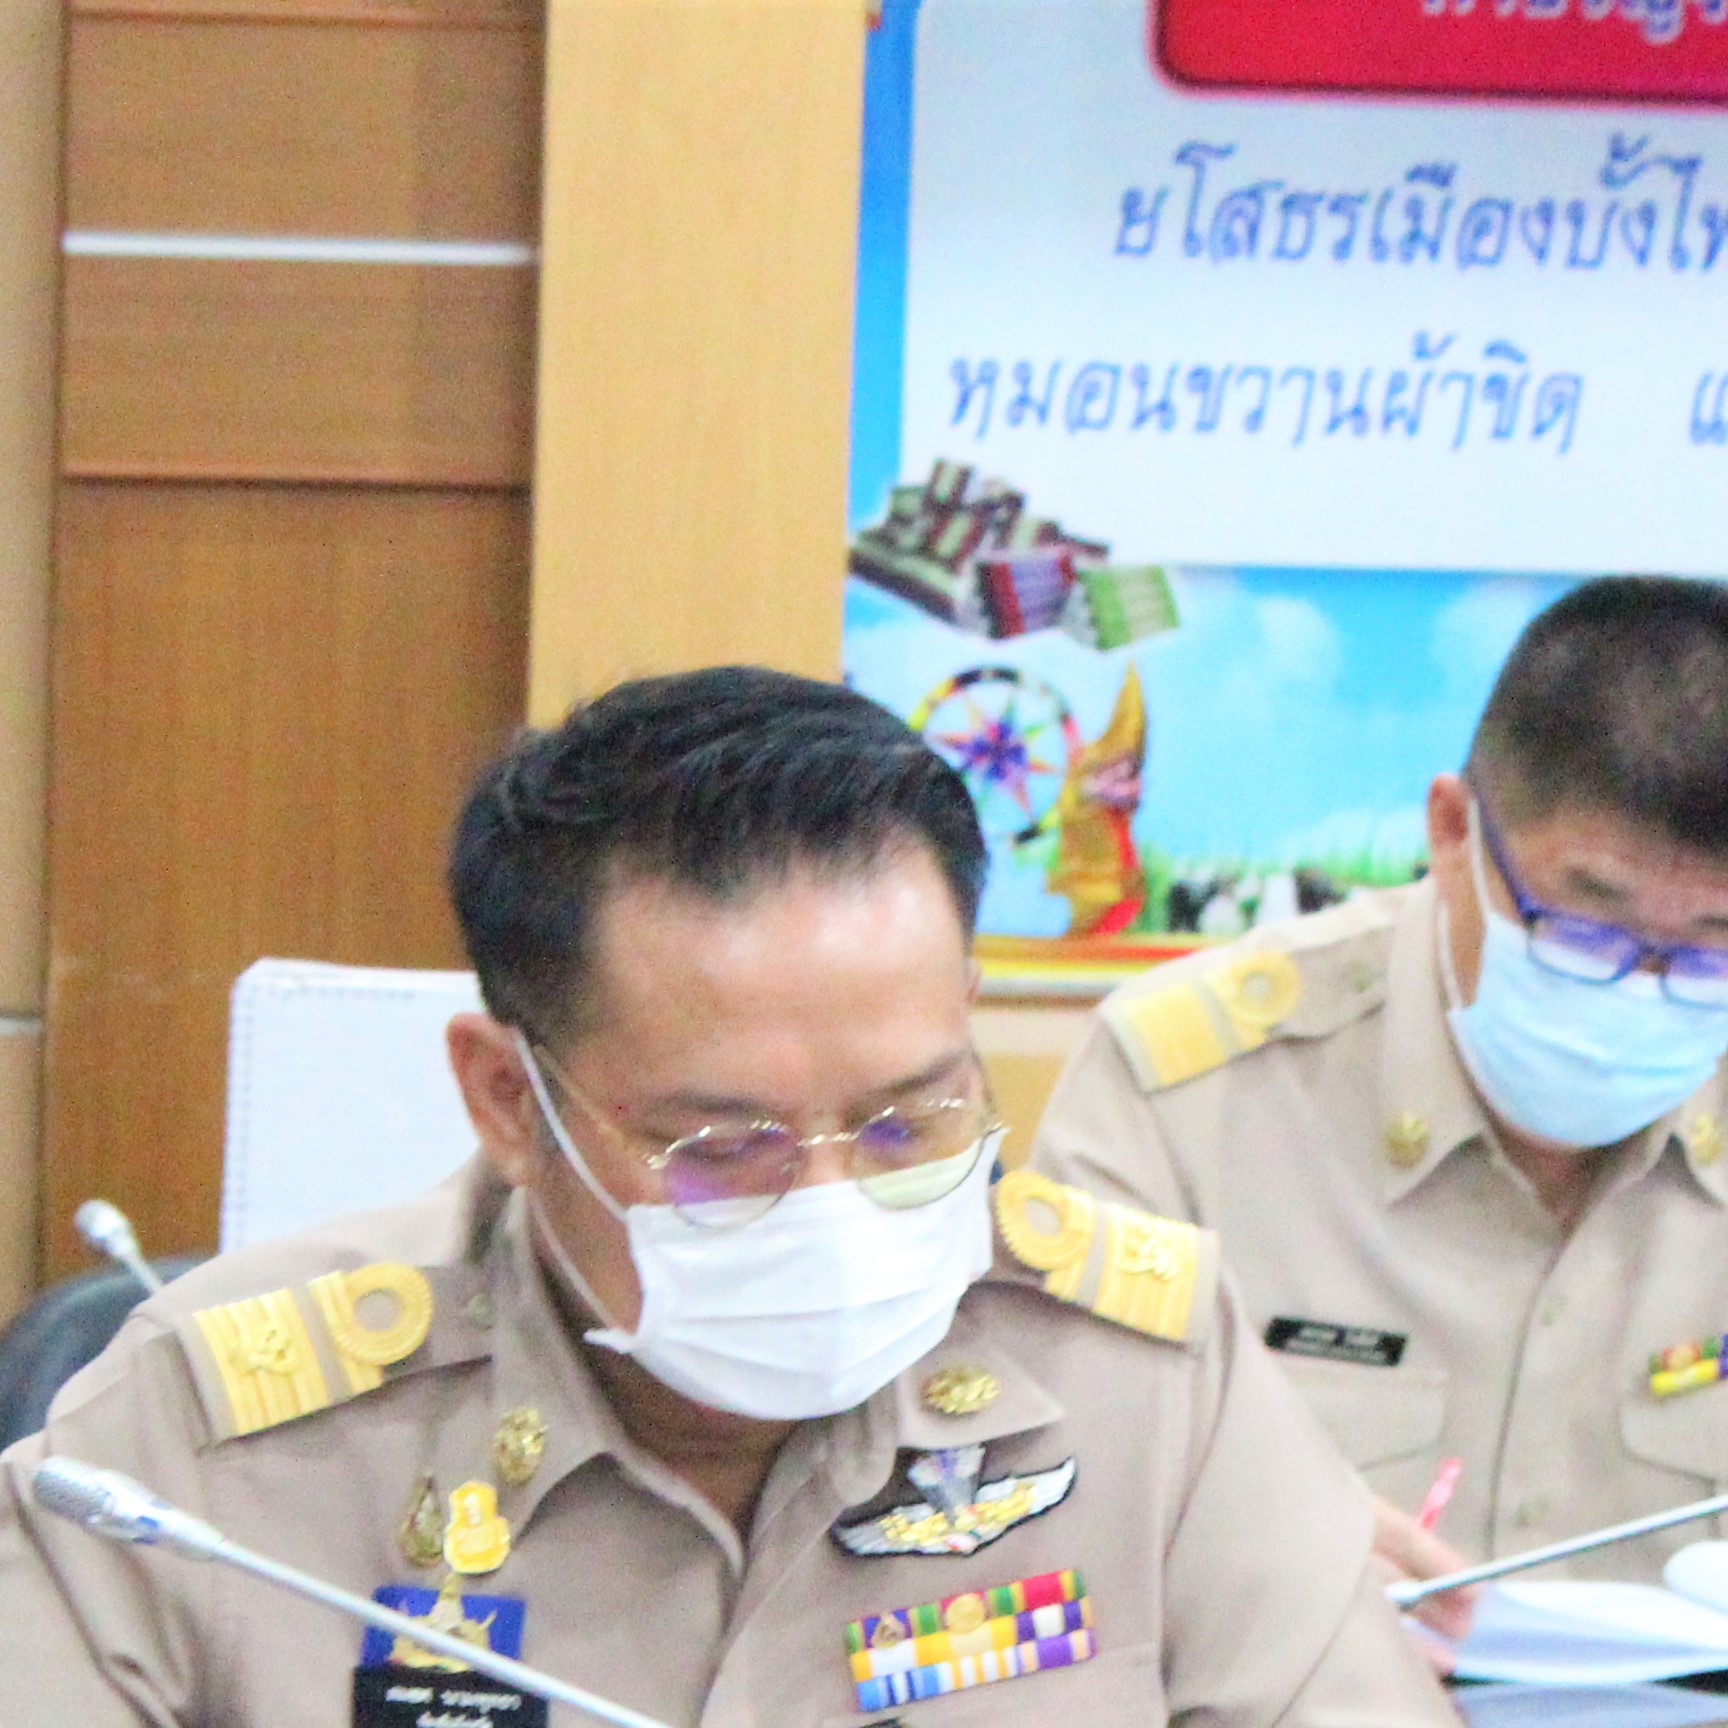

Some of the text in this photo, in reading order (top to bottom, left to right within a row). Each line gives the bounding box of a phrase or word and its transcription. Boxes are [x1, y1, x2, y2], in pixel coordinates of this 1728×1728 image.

[947, 329, 1585, 457] หมอนขวานผ้าขิด
